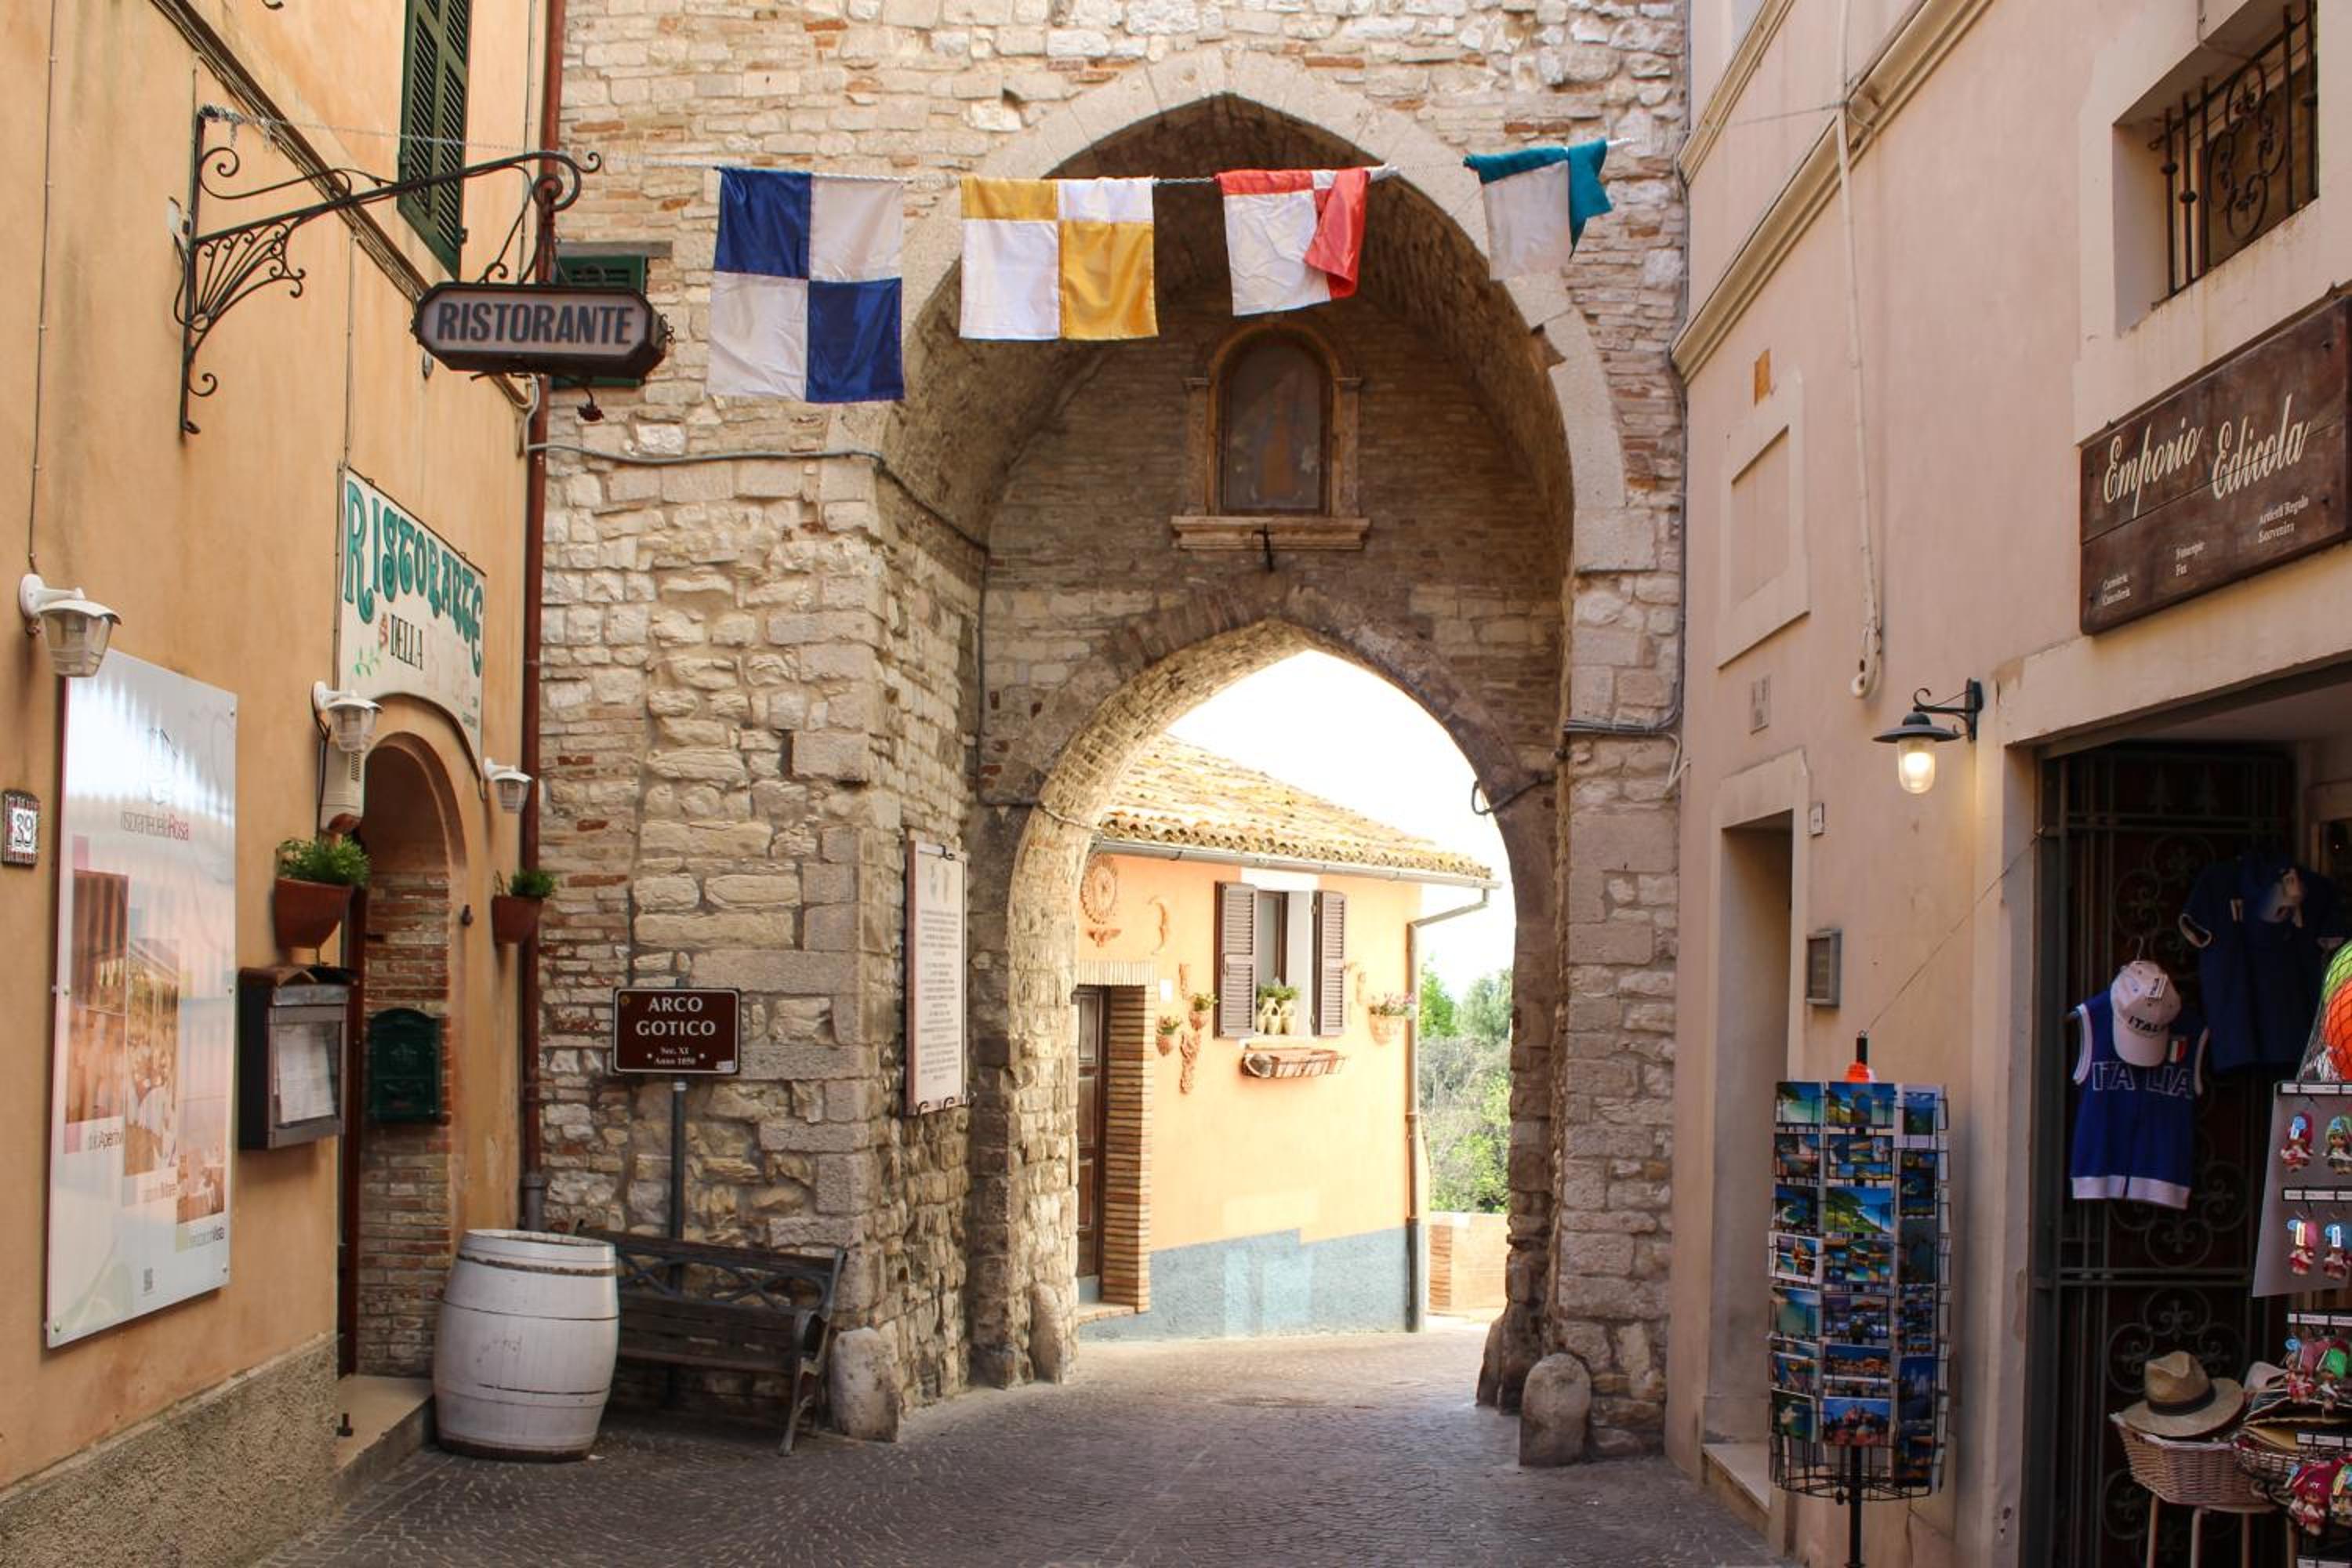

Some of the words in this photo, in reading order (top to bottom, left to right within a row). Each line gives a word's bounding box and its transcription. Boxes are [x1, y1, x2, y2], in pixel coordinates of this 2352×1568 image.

[437, 302, 635, 346] RISTORANTE
[2104, 417, 2204, 519] Emporio
[2212, 393, 2310, 500] Edicola
[344, 480, 484, 677] RISTORANTE
[390, 614, 423, 671] DELLA
[16, 813, 33, 847] 39
[648, 996, 703, 1013] ARCO
[635, 1020, 716, 1036] GOTICO
